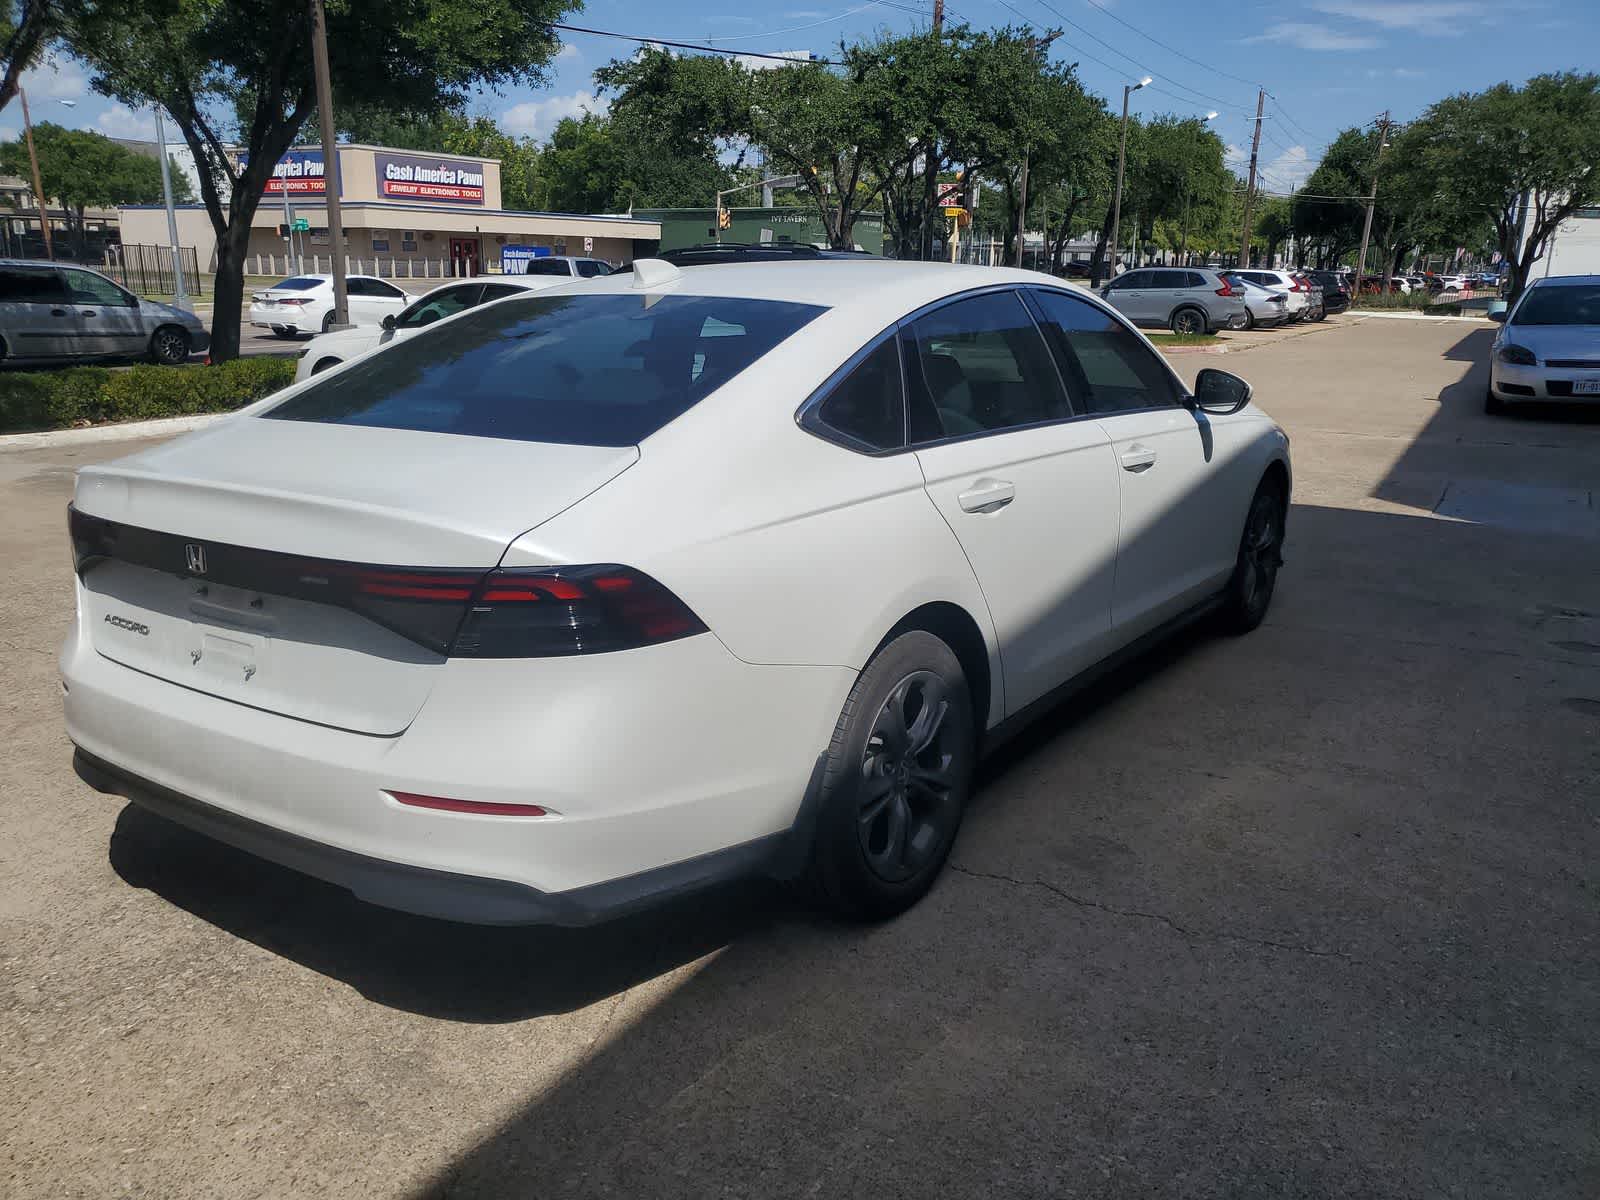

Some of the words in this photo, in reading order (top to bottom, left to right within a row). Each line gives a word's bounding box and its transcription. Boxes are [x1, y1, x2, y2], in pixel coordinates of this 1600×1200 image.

[304, 160, 325, 176] Paw
[386, 163, 413, 181] Cash
[414, 165, 456, 184] America
[457, 169, 483, 186] Pawn
[389, 184, 418, 192] JEWELRY
[420, 186, 460, 196] ELECTRONICS
[462, 190, 482, 198] TOOLS
[503, 259, 530, 275] PAW
[104, 613, 150, 636] ACCORD
